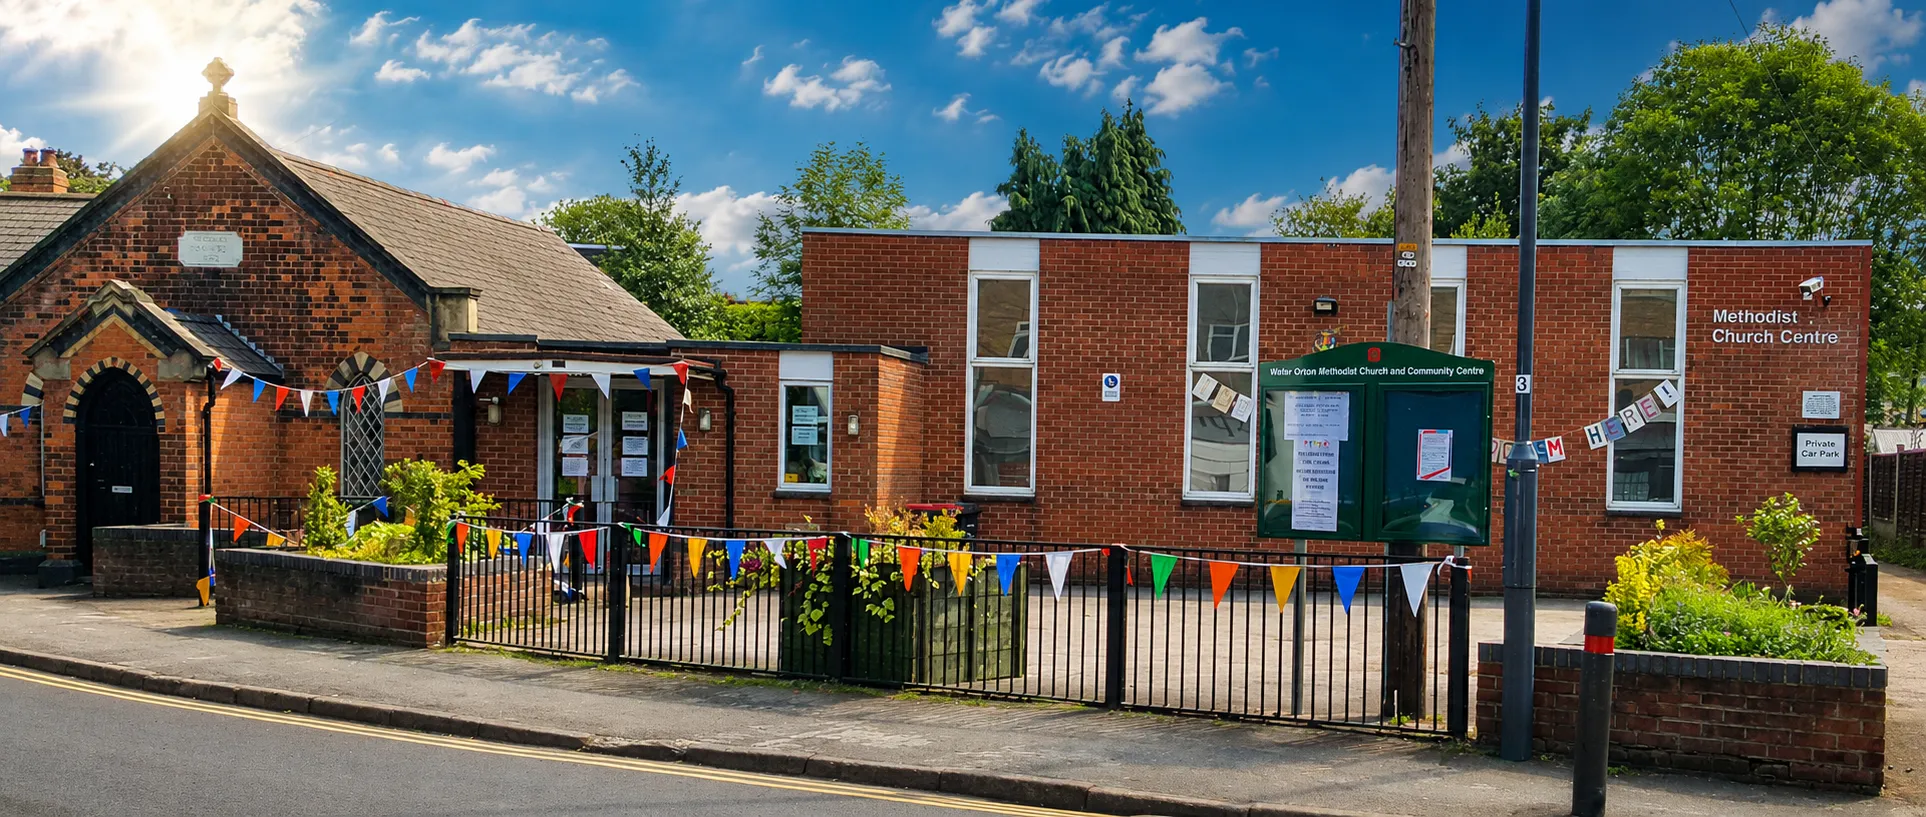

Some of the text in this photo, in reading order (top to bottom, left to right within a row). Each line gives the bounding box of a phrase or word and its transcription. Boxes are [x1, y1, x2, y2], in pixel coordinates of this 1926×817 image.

[1713, 309, 1798, 324] Methodist
[1712, 328, 1839, 344] Church Centre
[1294, 367, 1317, 376] Orton
[1318, 366, 1357, 376] Methodist
[1359, 366, 1388, 375] Church
[1390, 366, 1406, 375] and
[1407, 366, 1454, 377] Community
[1456, 366, 1485, 375] Centre
[1517, 376, 1527, 391] 3
[1587, 385, 1673, 445] HERE!
[1805, 440, 1836, 448] Private
[1801, 450, 1840, 458] Car Park
